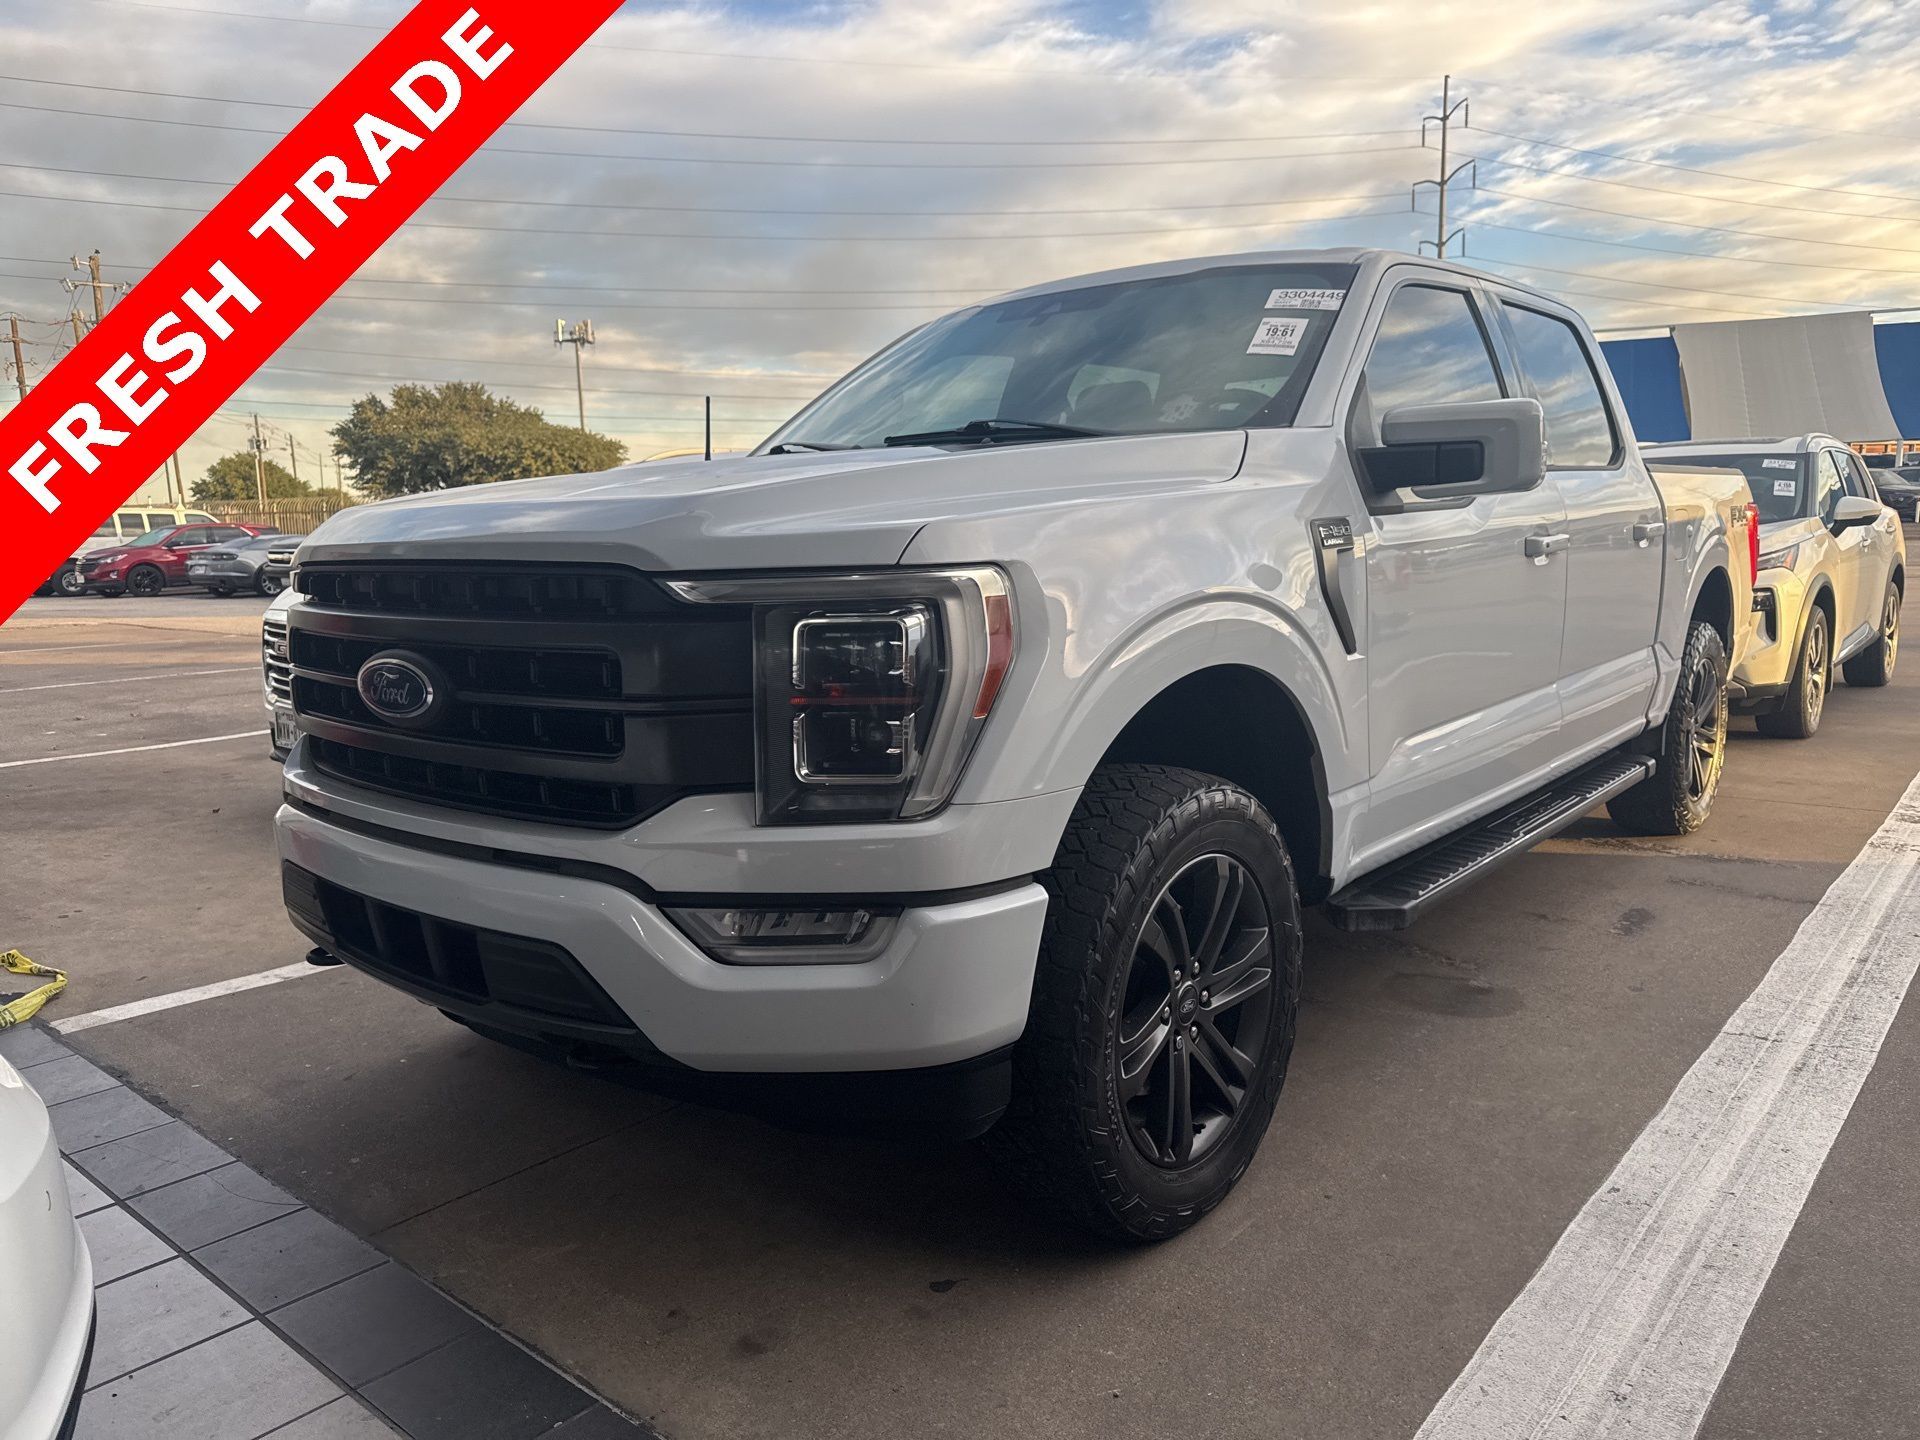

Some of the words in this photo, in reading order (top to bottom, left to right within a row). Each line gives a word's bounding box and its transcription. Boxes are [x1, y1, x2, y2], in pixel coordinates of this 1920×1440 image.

[1278, 291, 1344, 300] 3304449
[1265, 327, 1296, 337] 19:61
[370, 670, 410, 705] Ford
